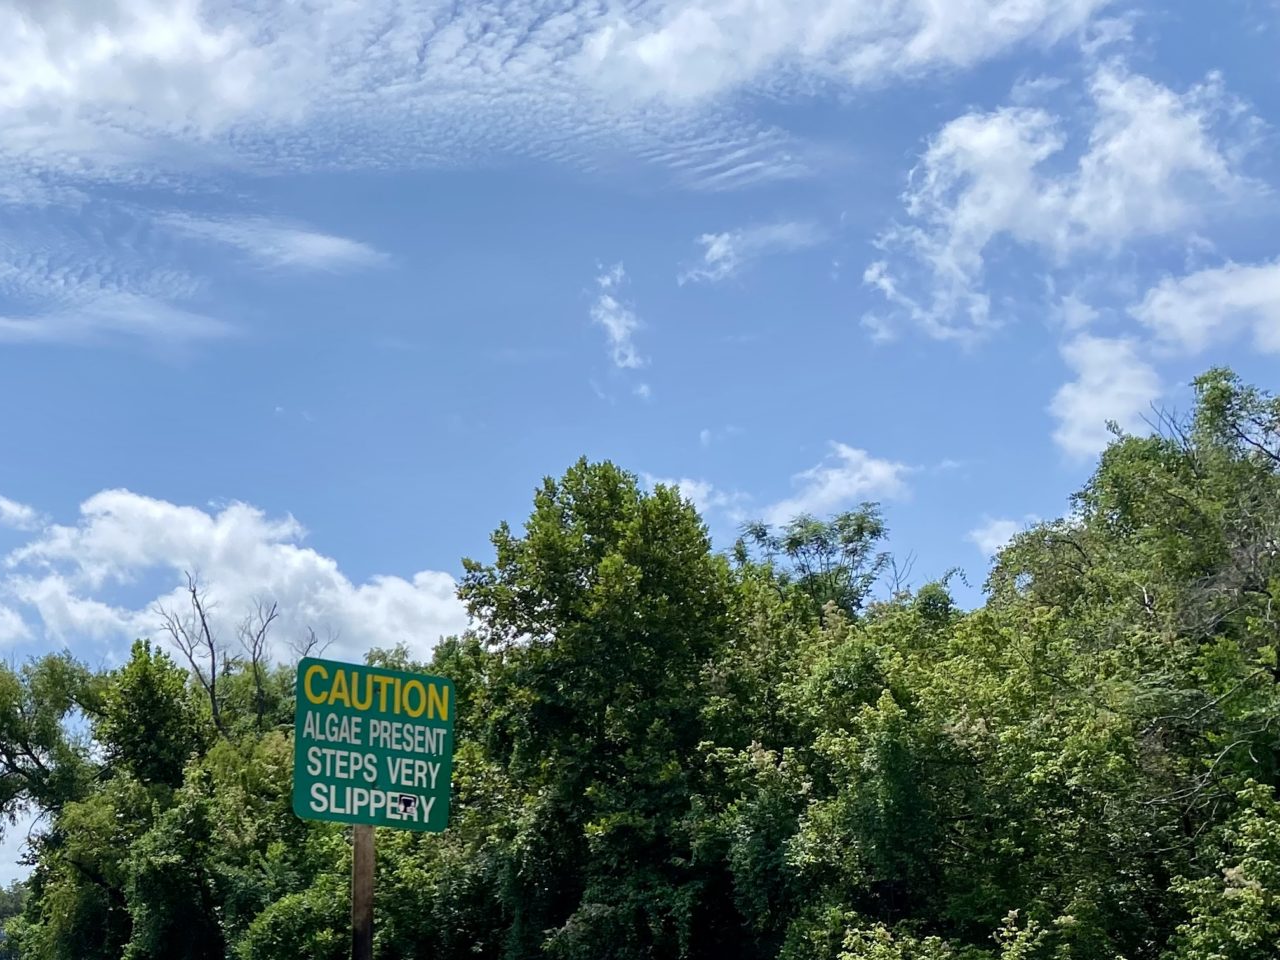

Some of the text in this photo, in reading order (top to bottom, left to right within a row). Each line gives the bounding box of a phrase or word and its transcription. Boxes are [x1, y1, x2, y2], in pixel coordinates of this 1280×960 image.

[304, 665, 449, 721] CAUTION
[303, 711, 447, 755] ALGAE PRESENT
[307, 747, 440, 788] STEPS VERY
